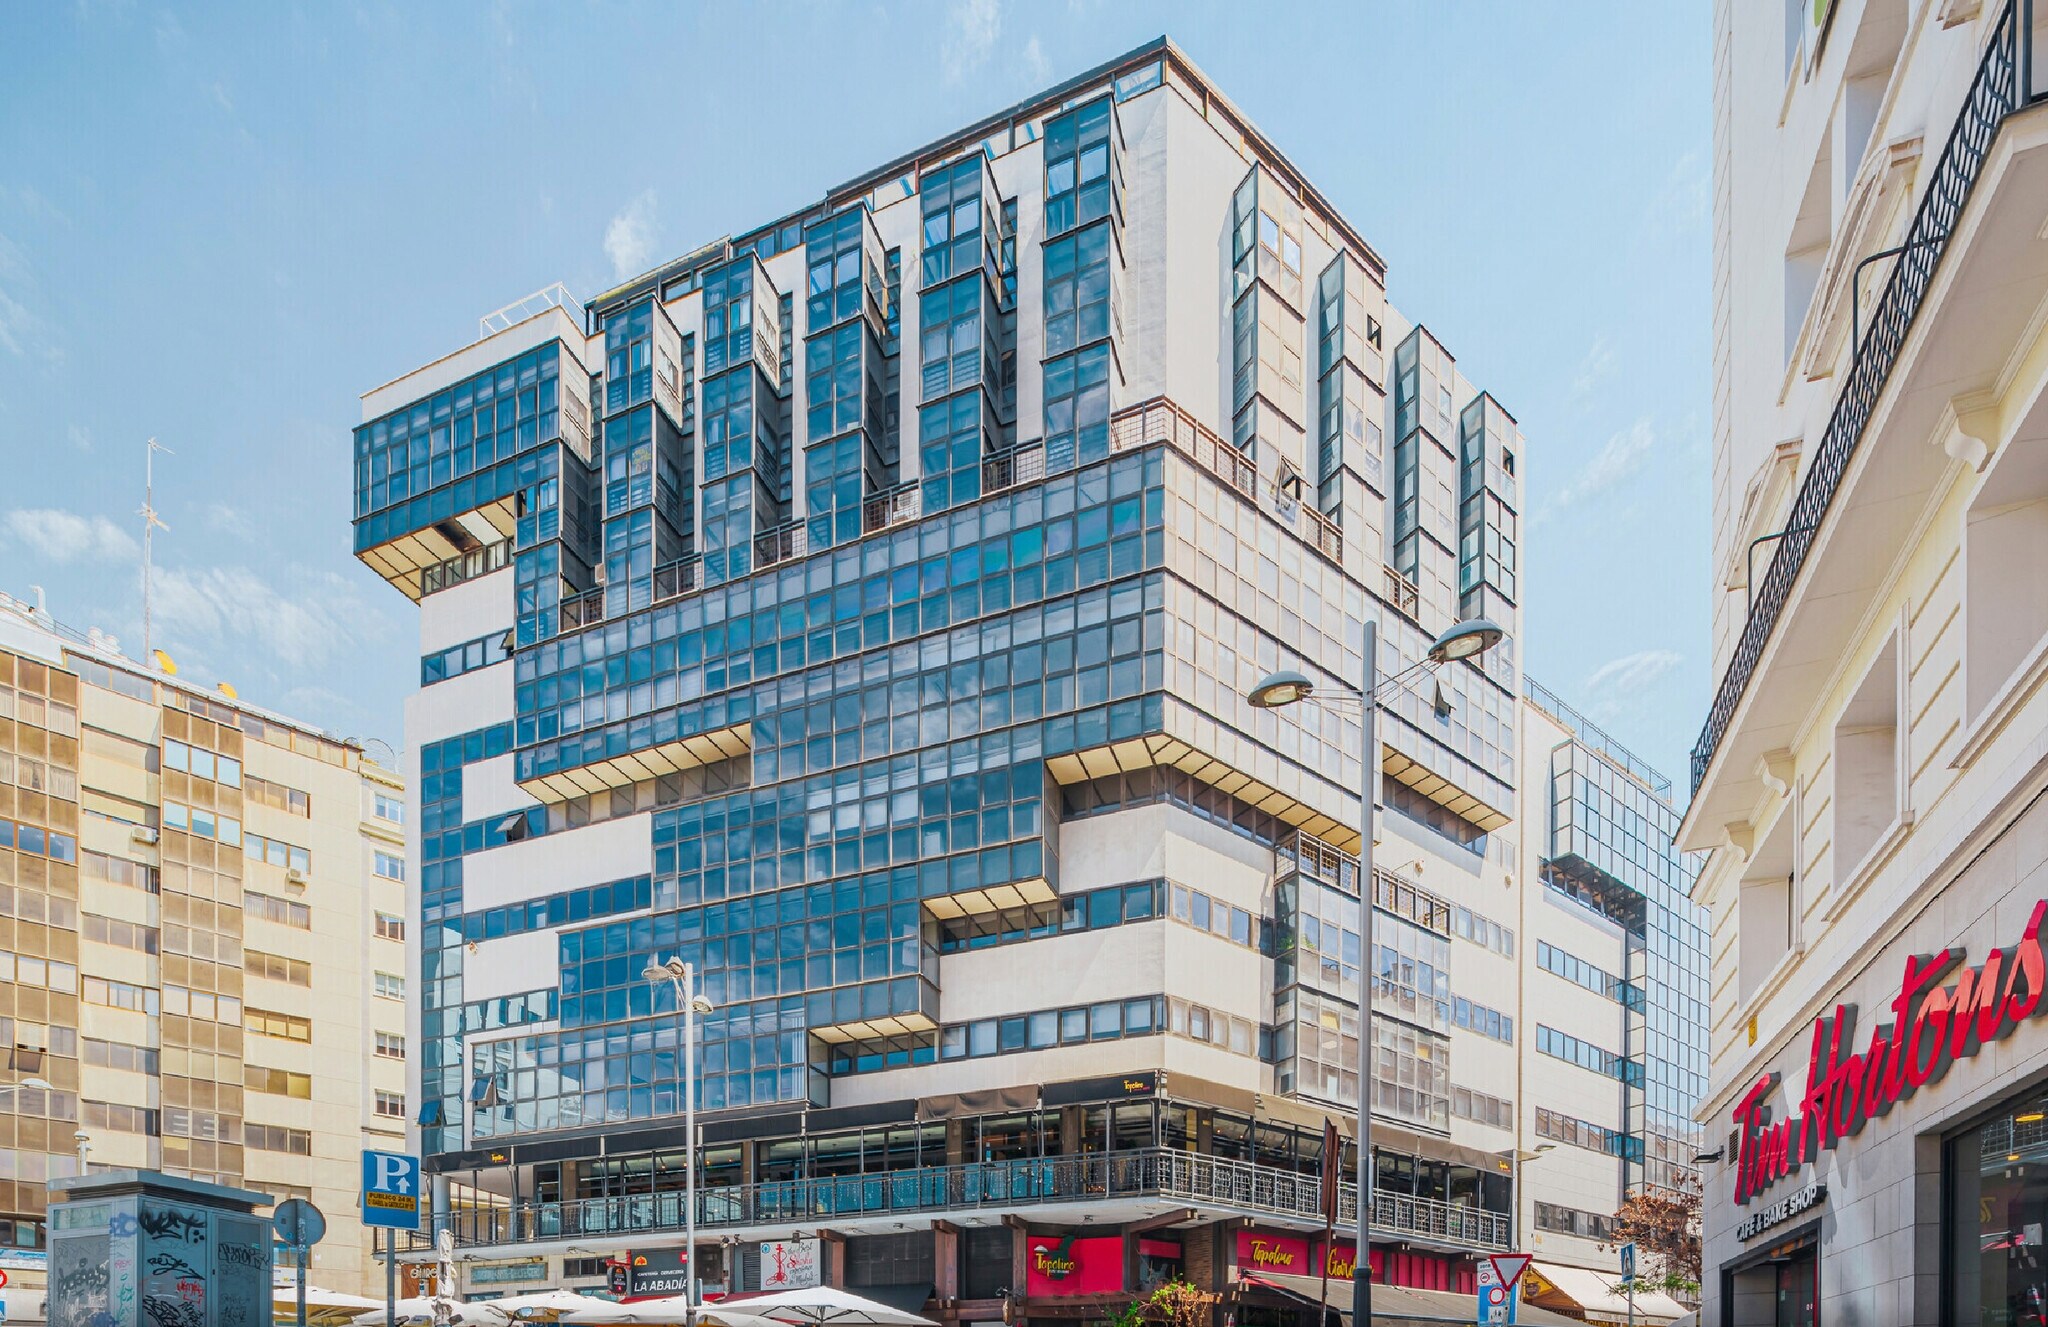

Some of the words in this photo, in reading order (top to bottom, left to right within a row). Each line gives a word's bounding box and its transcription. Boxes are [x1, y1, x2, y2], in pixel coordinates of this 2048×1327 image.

[1732, 1072, 1794, 1206] Tim
[1798, 898, 2047, 1163] Hortons
[373, 1154, 411, 1191] P
[1756, 1213, 1763, 1232] &
[1763, 1199, 1787, 1228] BAKE
[1789, 1185, 1817, 1214] SHOP
[1035, 1253, 1075, 1277] Topolino
[1250, 1240, 1295, 1268] Topolino
[1327, 1247, 1374, 1279] Gard
[634, 1282, 647, 1292] LA
